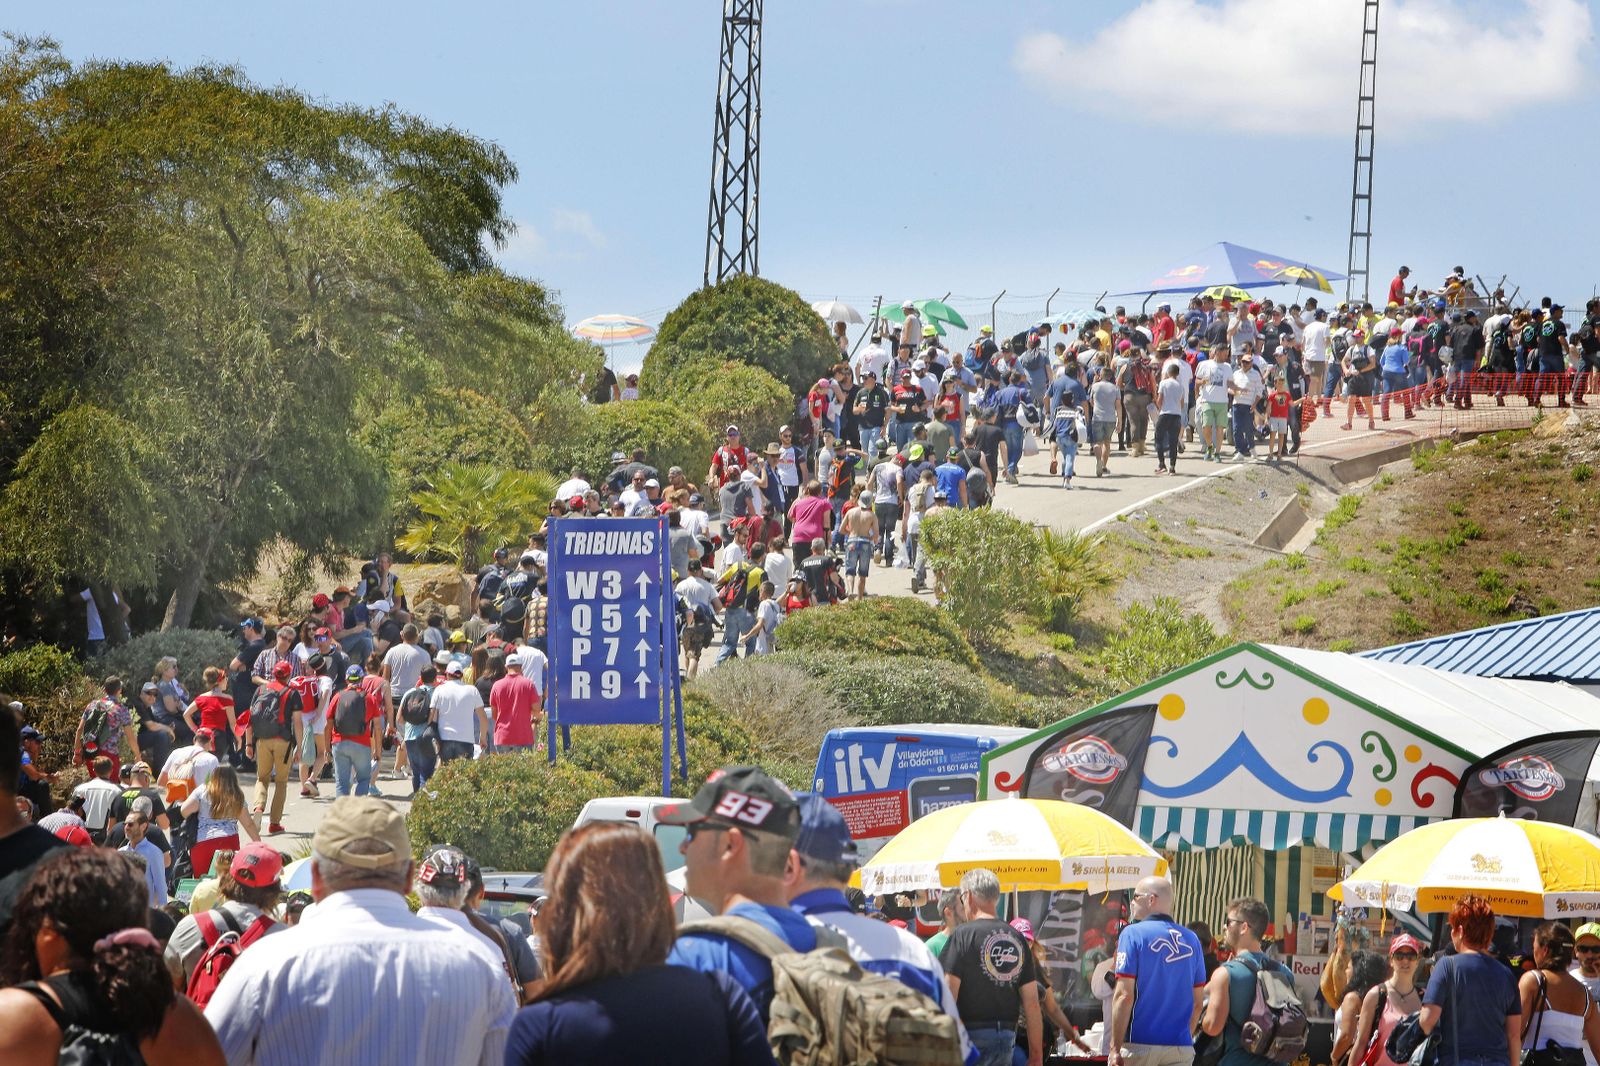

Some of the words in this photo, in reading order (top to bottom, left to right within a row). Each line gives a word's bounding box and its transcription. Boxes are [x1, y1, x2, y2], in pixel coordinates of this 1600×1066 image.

[564, 531, 654, 556] TRIBUNAS
[565, 571, 599, 600] W
[602, 570, 622, 600] 3
[571, 604, 592, 636] Q
[601, 604, 622, 633] 5
[572, 638, 592, 666] P
[603, 637, 619, 666] 7
[571, 671, 591, 700] R
[601, 670, 621, 700] 9
[834, 742, 897, 794] itv
[897, 748, 944, 760] Villaviciosa
[715, 791, 774, 826] 93
[1116, 865, 1140, 876] BEER
[1294, 961, 1320, 976] Red
